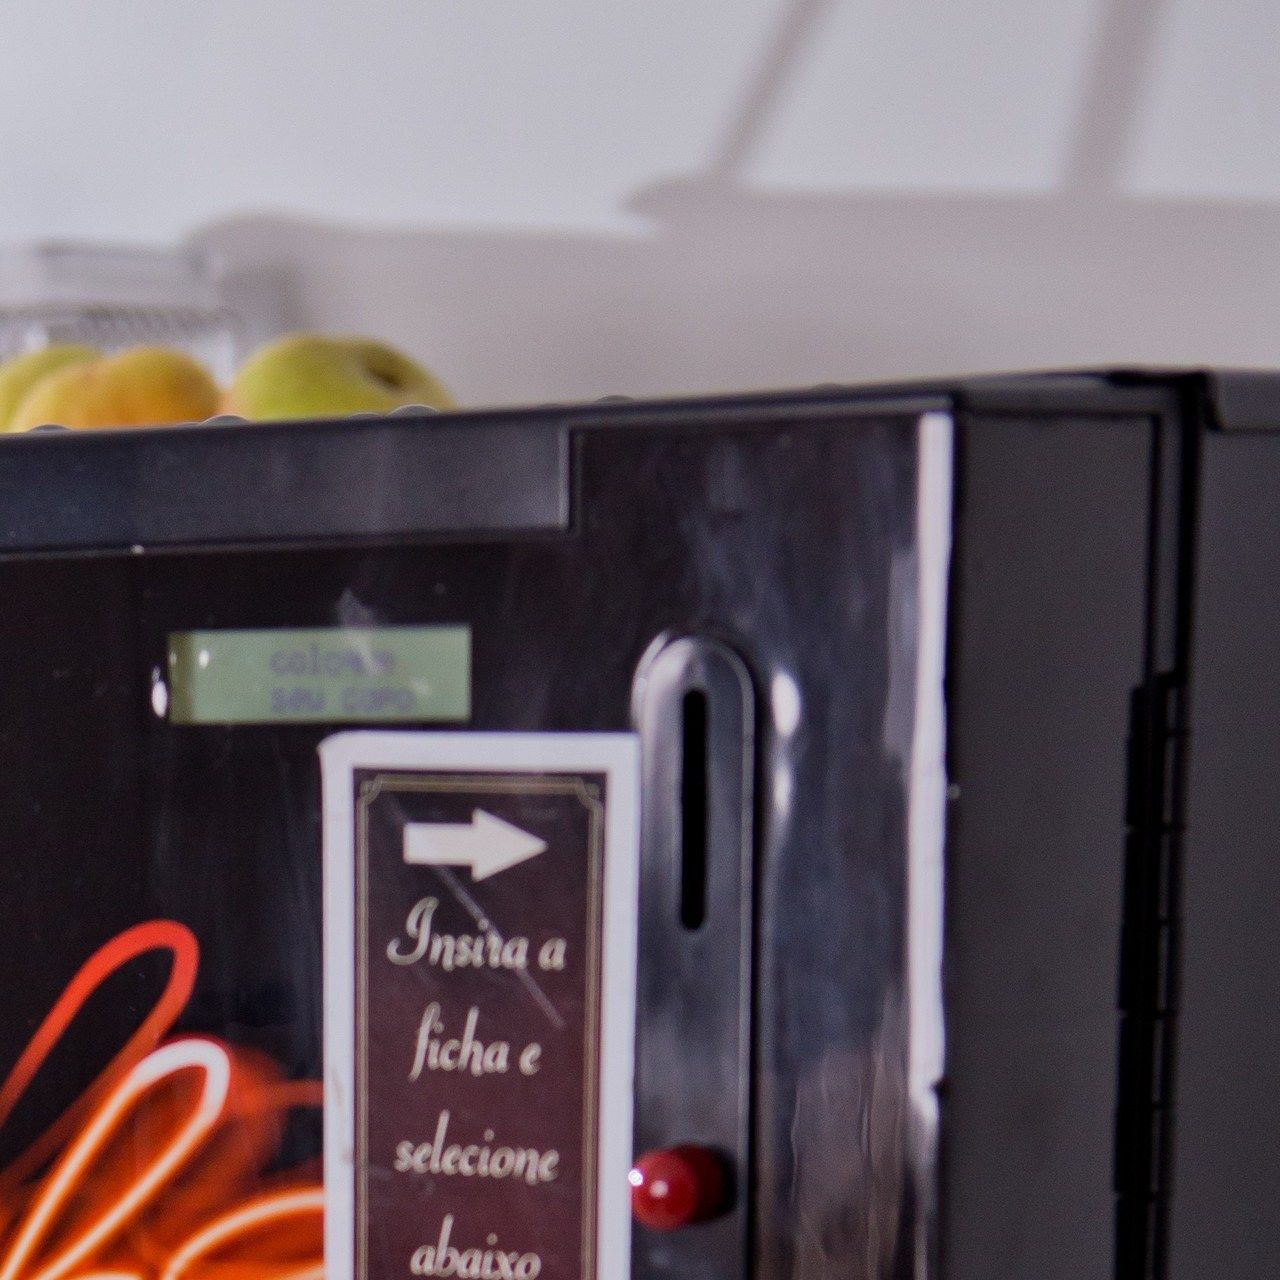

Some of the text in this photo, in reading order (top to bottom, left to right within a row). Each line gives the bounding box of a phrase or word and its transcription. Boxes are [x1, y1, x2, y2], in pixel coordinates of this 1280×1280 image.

[386, 896, 568, 971] Insira a
[408, 1001, 542, 1081] ficha e
[394, 1109, 560, 1186] selecione
